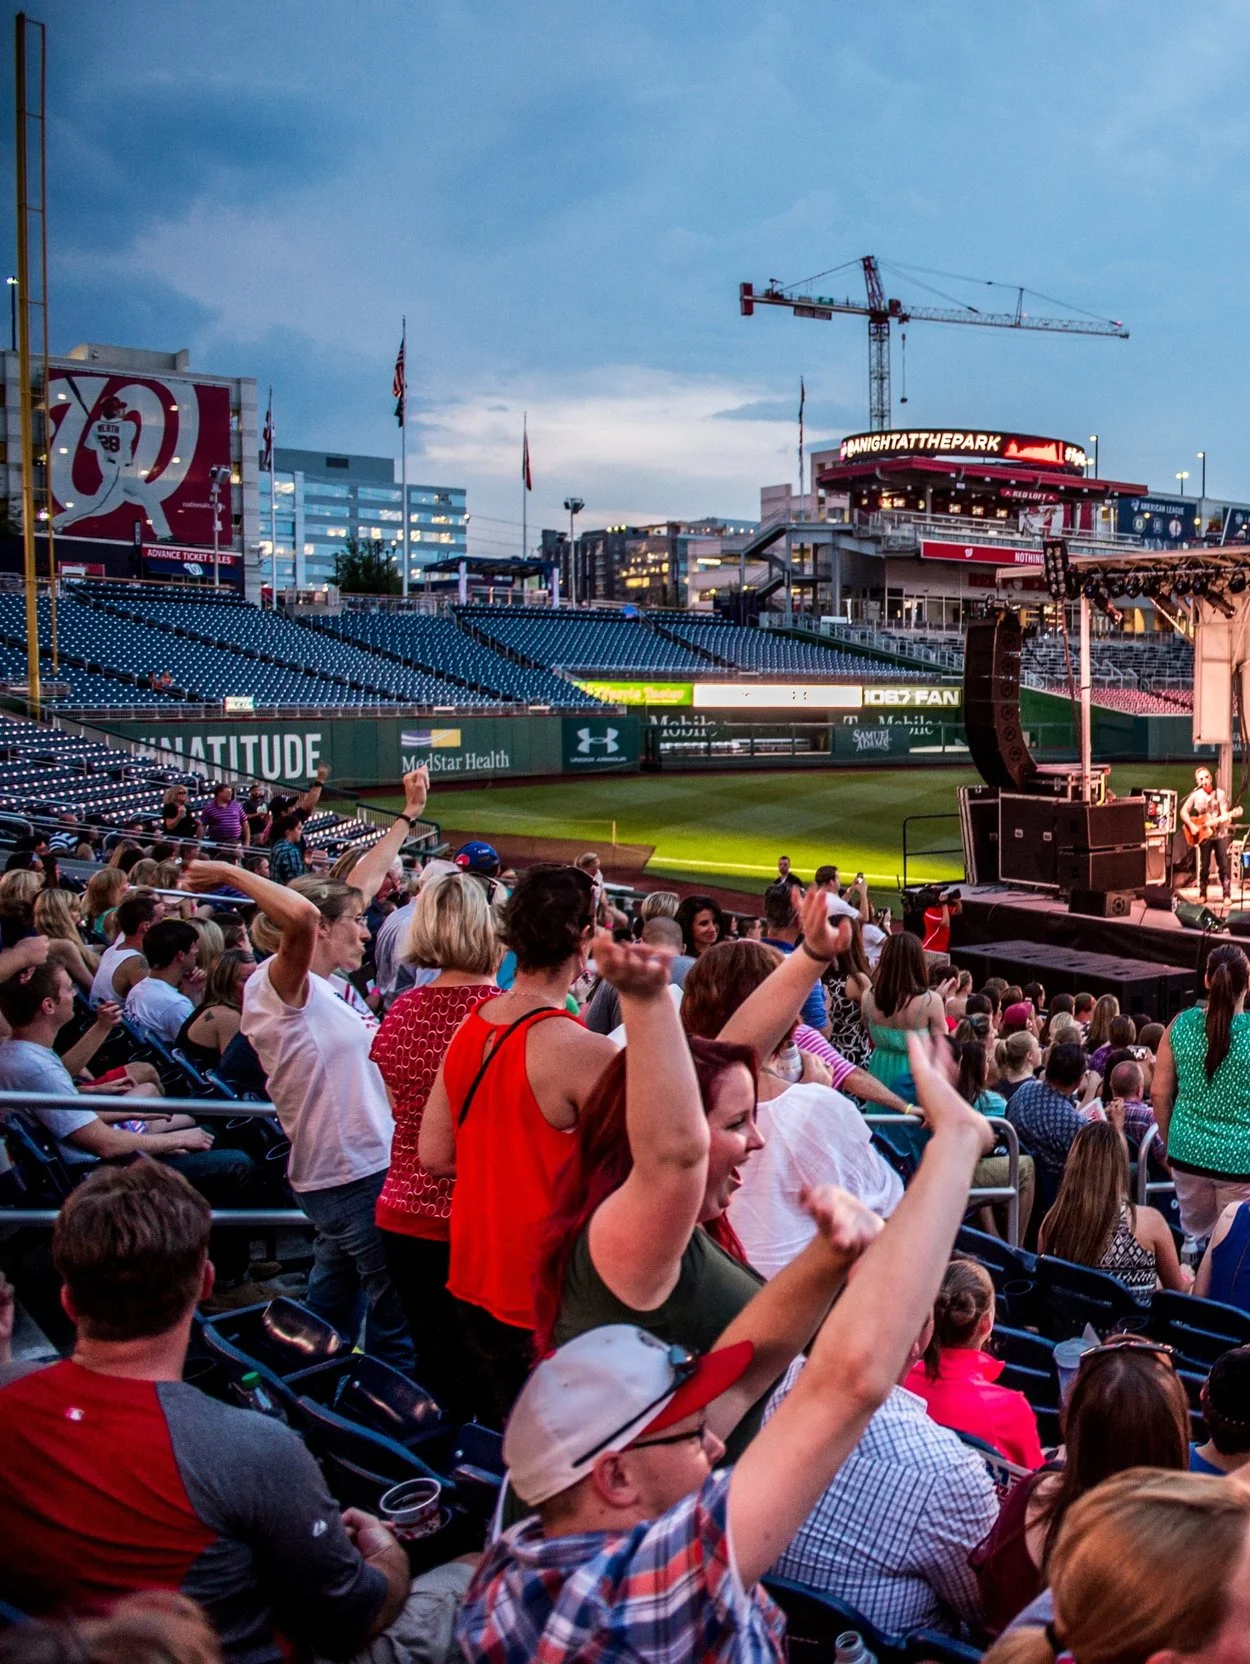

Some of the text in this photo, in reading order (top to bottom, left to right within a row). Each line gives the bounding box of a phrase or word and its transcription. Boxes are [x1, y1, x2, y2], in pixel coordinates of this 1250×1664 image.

[97, 434, 121, 453] 28
[182, 502, 226, 511] nationals.cm
[1140, 502, 1185, 516] AMERICAN LEAGUE
[147, 549, 232, 564] ADVANCE TICKET SLES
[1014, 551, 1045, 564] NOTHING
[914, 690, 959, 705] FAN
[852, 728, 892, 742] SAMUEL
[855, 738, 891, 752] ADAMS
[401, 750, 510, 773] MedStar Health
